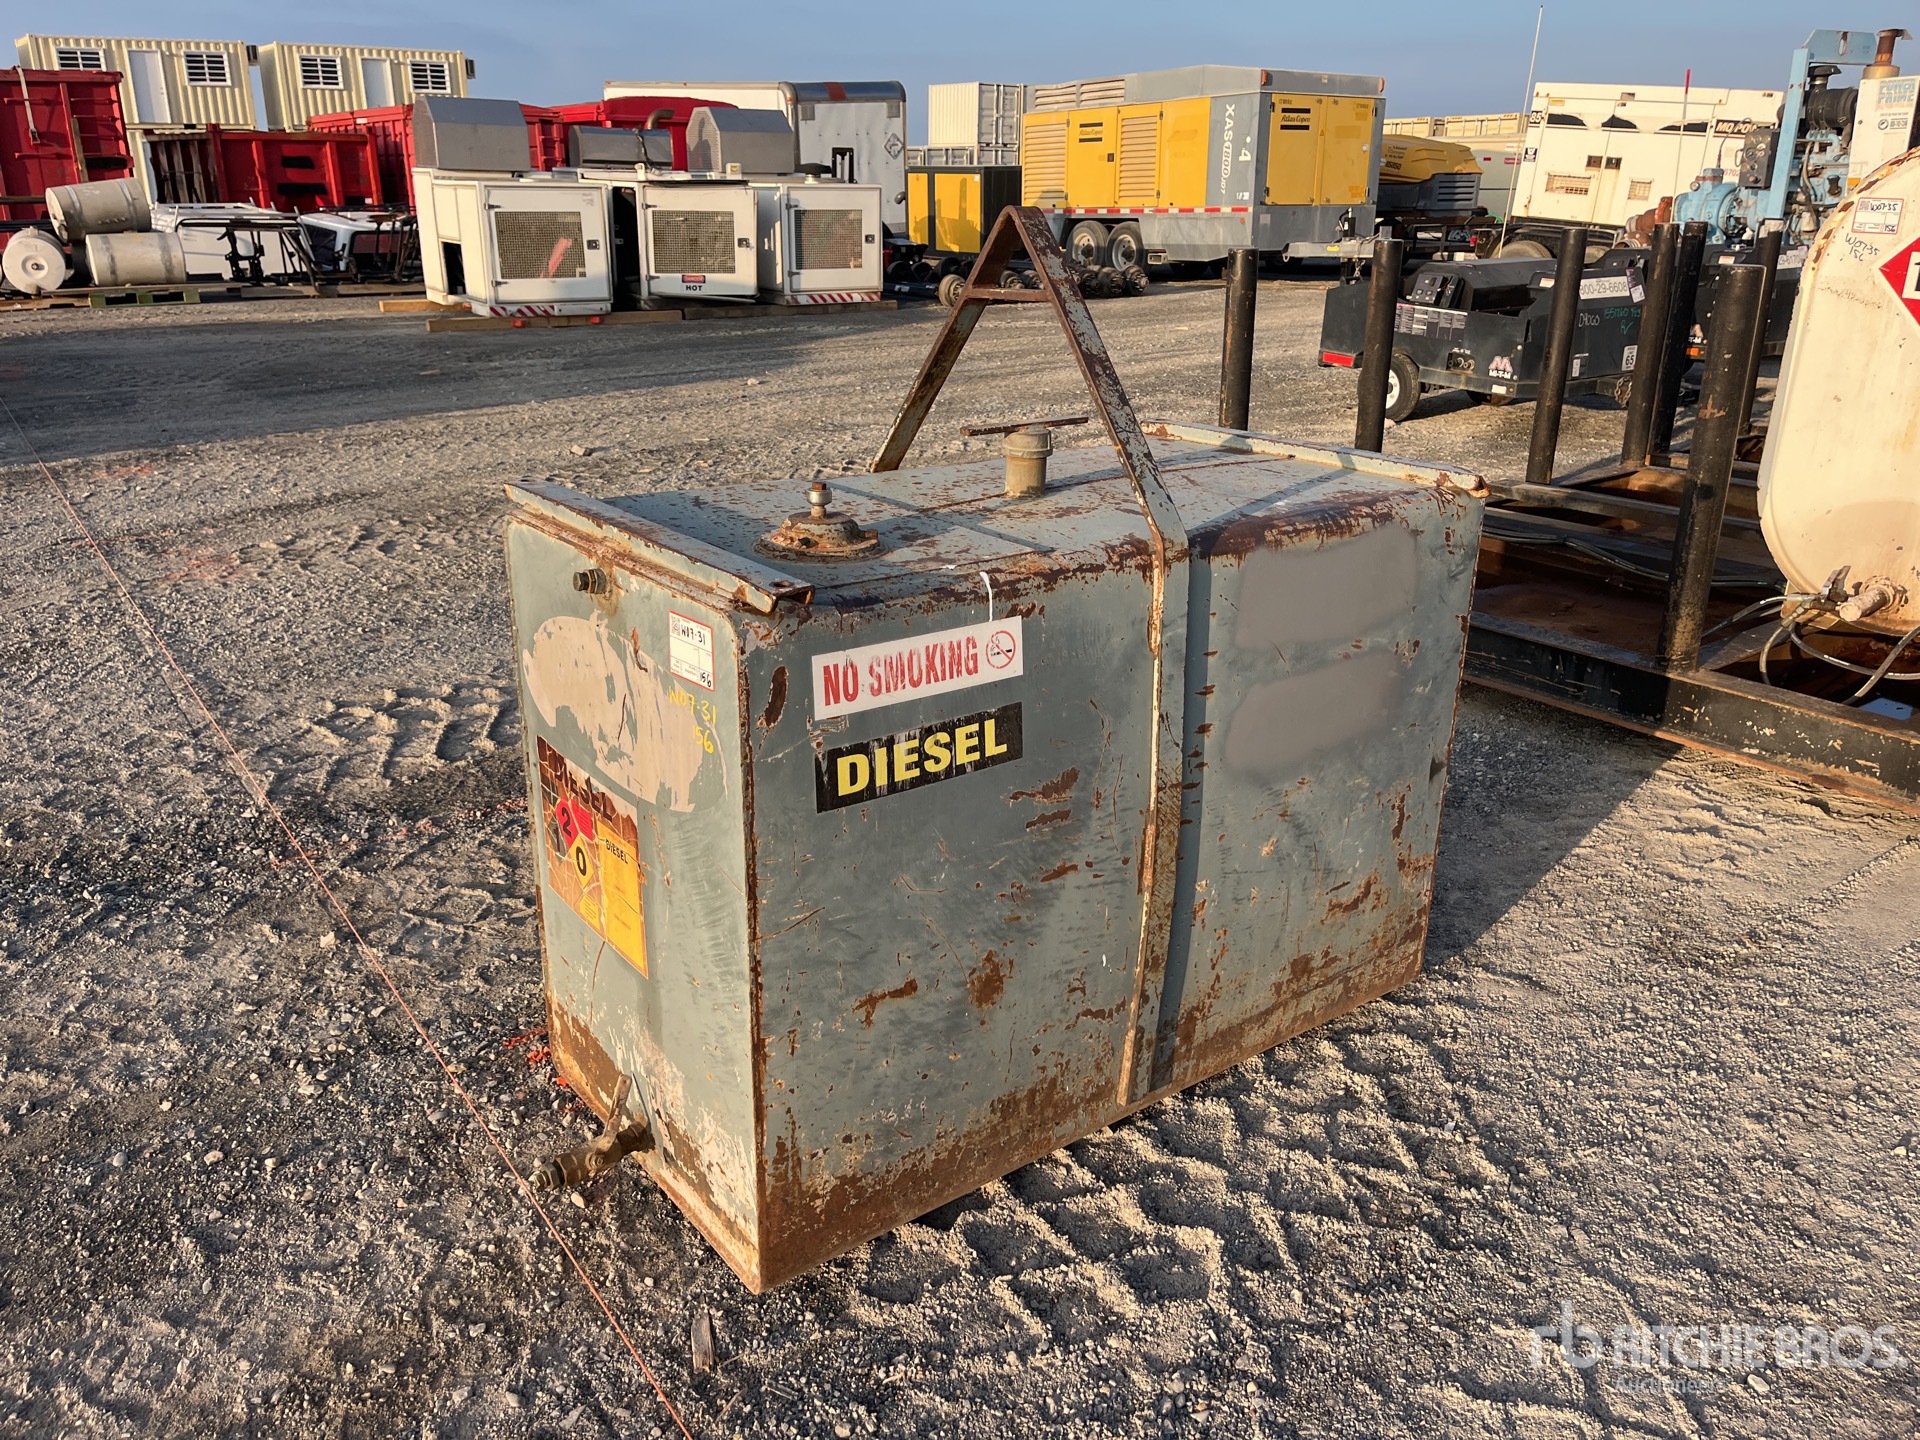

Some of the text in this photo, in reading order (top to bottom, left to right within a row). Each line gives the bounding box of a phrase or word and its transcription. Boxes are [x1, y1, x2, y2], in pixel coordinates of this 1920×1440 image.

[1625, 355, 1635, 366] 65
[823, 636, 979, 707] NO SMOKING
[836, 718, 1008, 797] DIESEL
[560, 805, 573, 839] 2
[575, 846, 588, 877] 0
[604, 838, 629, 866] DIESEL
